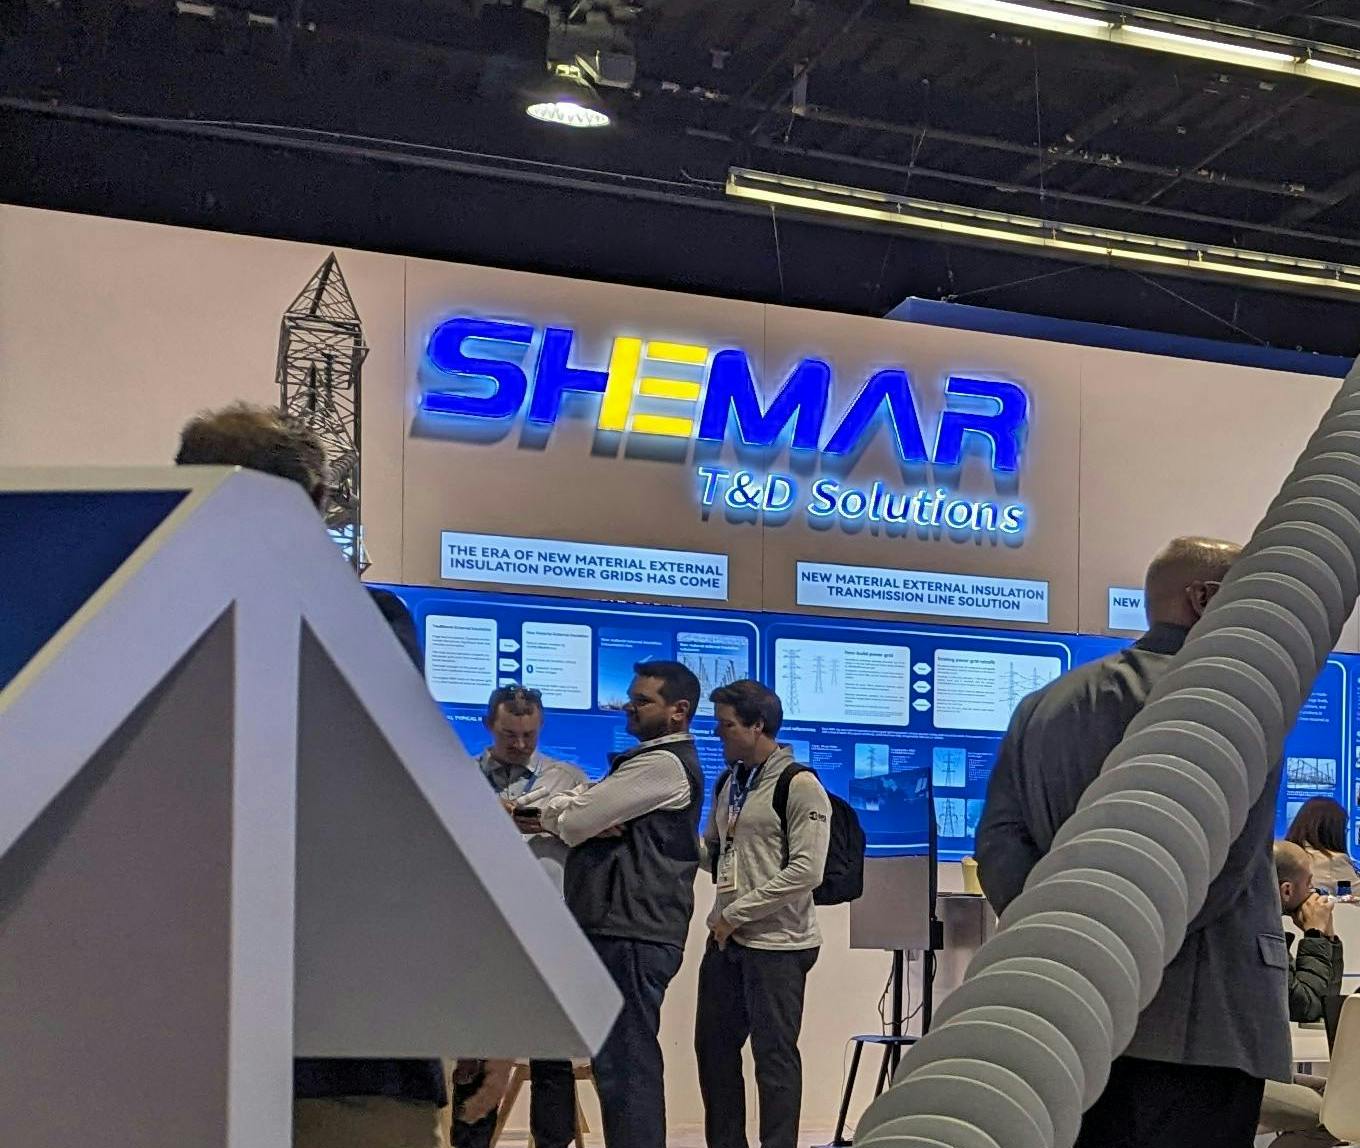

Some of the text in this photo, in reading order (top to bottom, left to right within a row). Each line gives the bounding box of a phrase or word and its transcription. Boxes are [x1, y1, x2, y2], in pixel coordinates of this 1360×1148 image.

[420, 318, 1028, 471] SHEMAR
[698, 467, 1025, 533] T&D Solutions
[448, 544, 723, 576] THE ERA OF NEW MATERIAL EXTERNAL
[450, 557, 720, 588] INSULATION POWER GRIDS HAS COME
[801, 572, 1045, 600] NEW MATERIAL EXTERNAL INSULATION
[827, 586, 1021, 610] TRANSMISSION LINE SOLUTION
[1113, 597, 1141, 608] NEW
